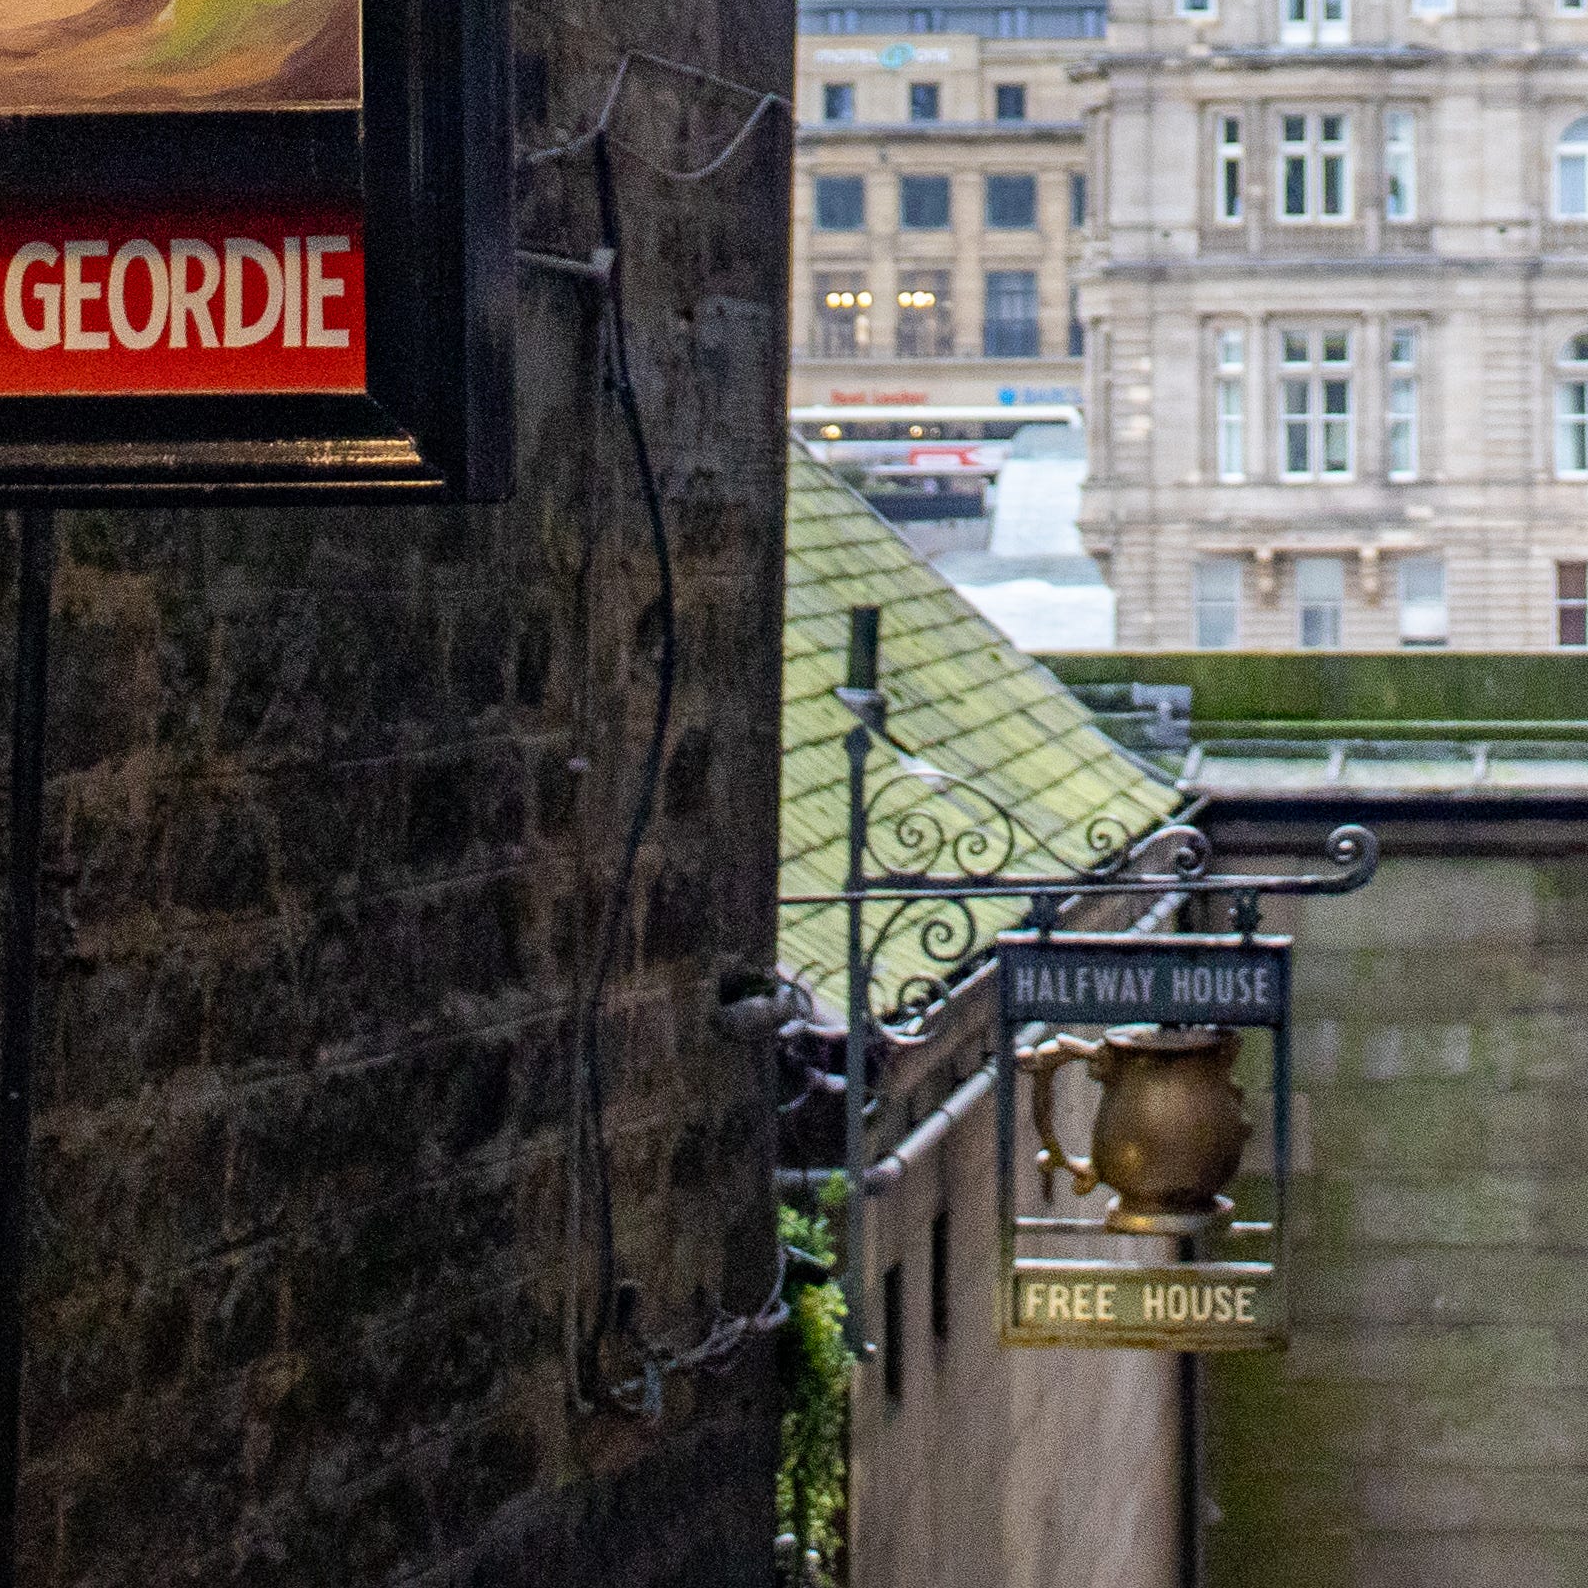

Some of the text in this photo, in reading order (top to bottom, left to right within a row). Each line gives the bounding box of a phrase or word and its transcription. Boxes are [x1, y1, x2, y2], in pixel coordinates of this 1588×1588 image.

[3, 236, 351, 351] GEORDIE
[1014, 966, 1271, 1005] HALFWAY HOUSE
[1024, 1283, 1258, 1324] FREE HOUSE
